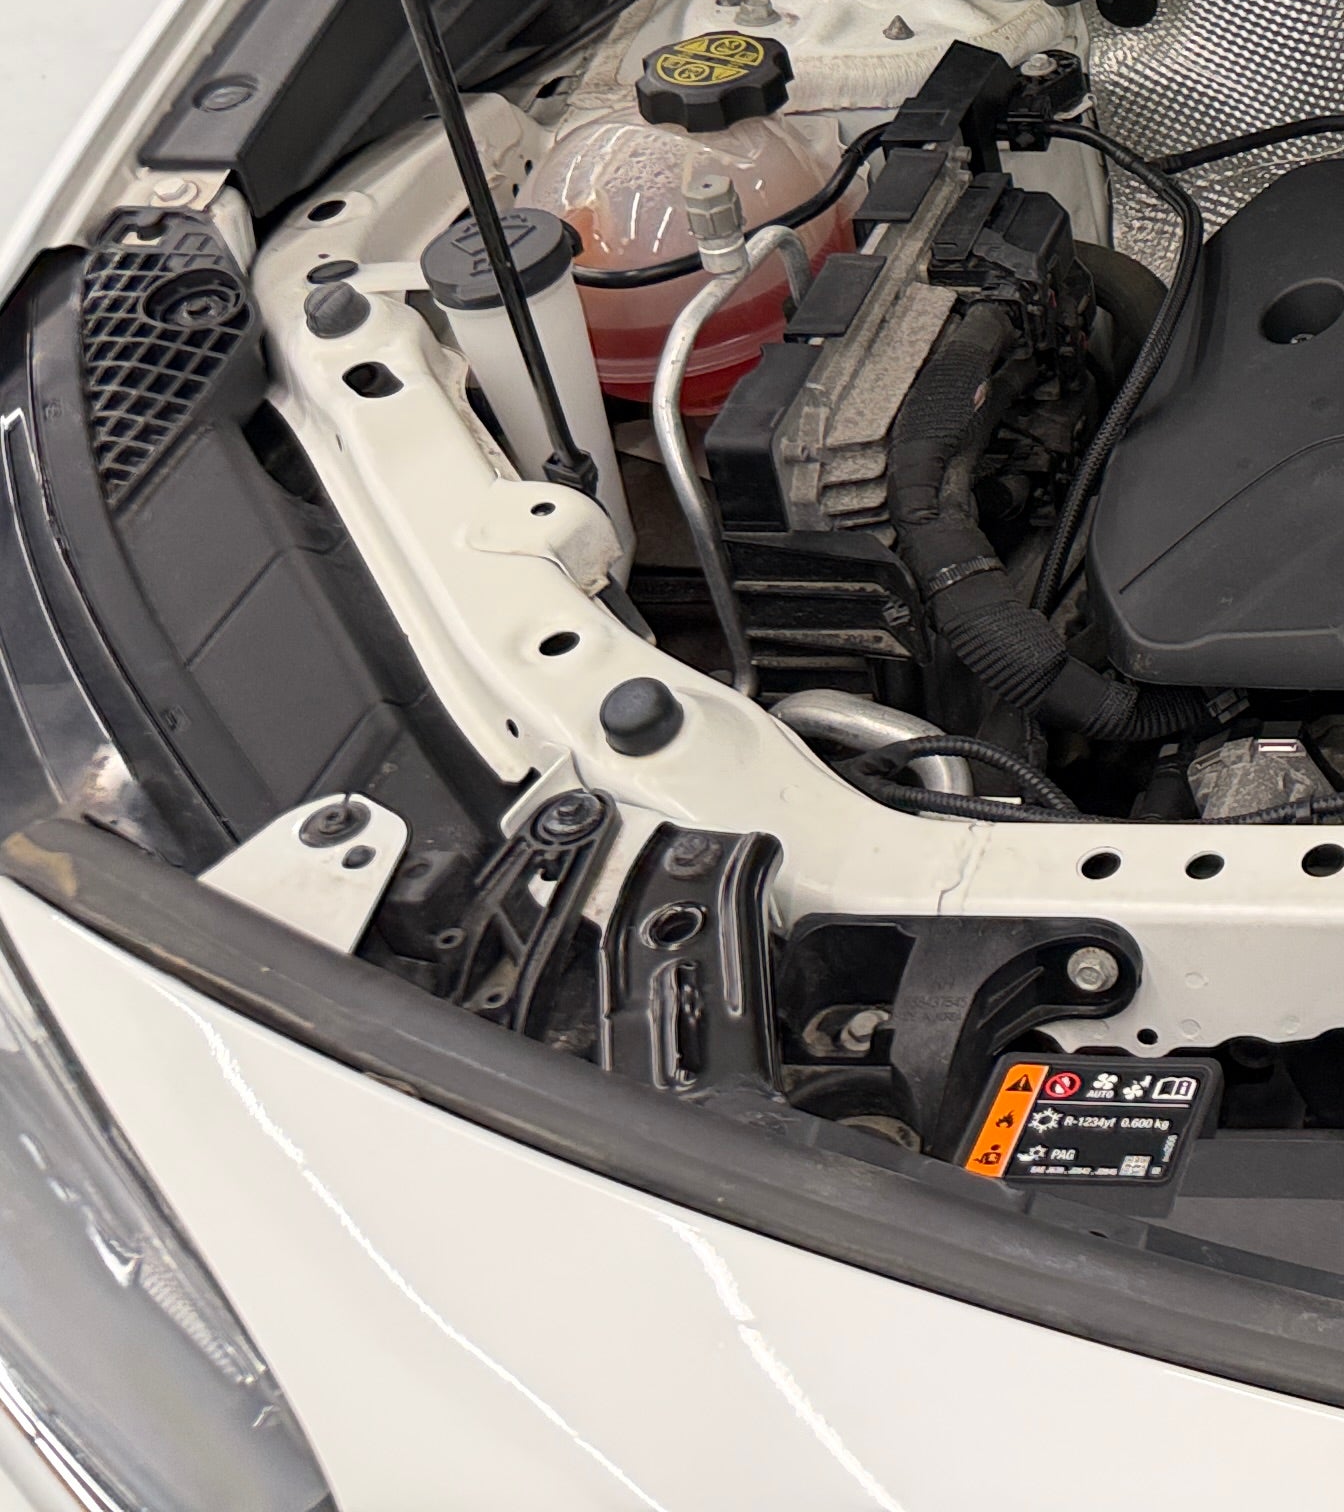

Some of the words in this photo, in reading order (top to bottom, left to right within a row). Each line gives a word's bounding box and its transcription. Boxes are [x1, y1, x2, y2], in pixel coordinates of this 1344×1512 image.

[1086, 1090, 1114, 1099] AUTO
[1064, 1115, 1117, 1129] R-1234yf
[1120, 1117, 1153, 1129] 0.600
[1154, 1118, 1170, 1131] kg
[1050, 1149, 1076, 1161] PAG
